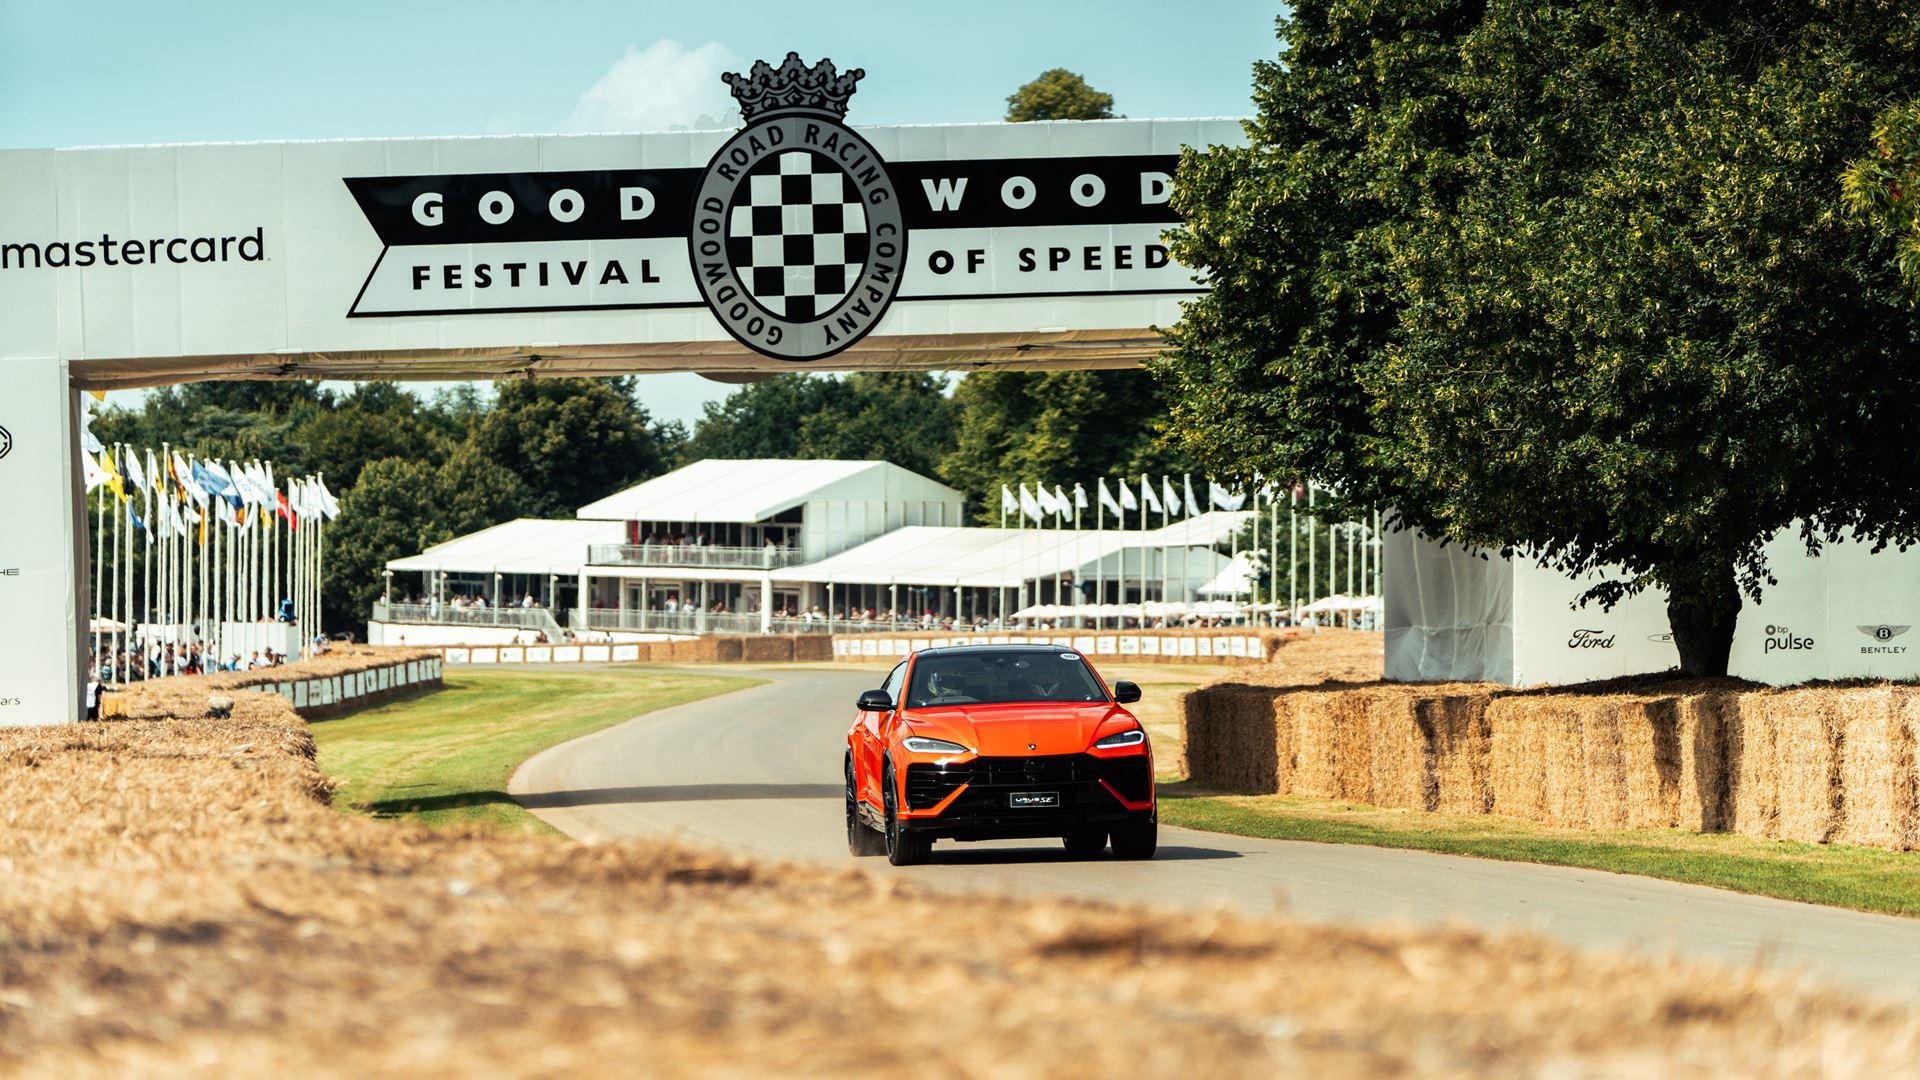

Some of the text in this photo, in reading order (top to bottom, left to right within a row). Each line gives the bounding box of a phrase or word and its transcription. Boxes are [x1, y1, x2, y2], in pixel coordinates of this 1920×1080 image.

[411, 171, 1174, 227] GOOD WOOD
[1, 226, 264, 269] mastercard
[699, 123, 897, 346] GOODWOOD ROAD RACING COMPANY
[412, 244, 1170, 290] FESTIVAL OF SPEED
[1568, 629, 1616, 648] Ford
[1764, 632, 1815, 654] pulse
[1777, 626, 1789, 634] bp
[1860, 646, 1908, 654] BENTLEY
